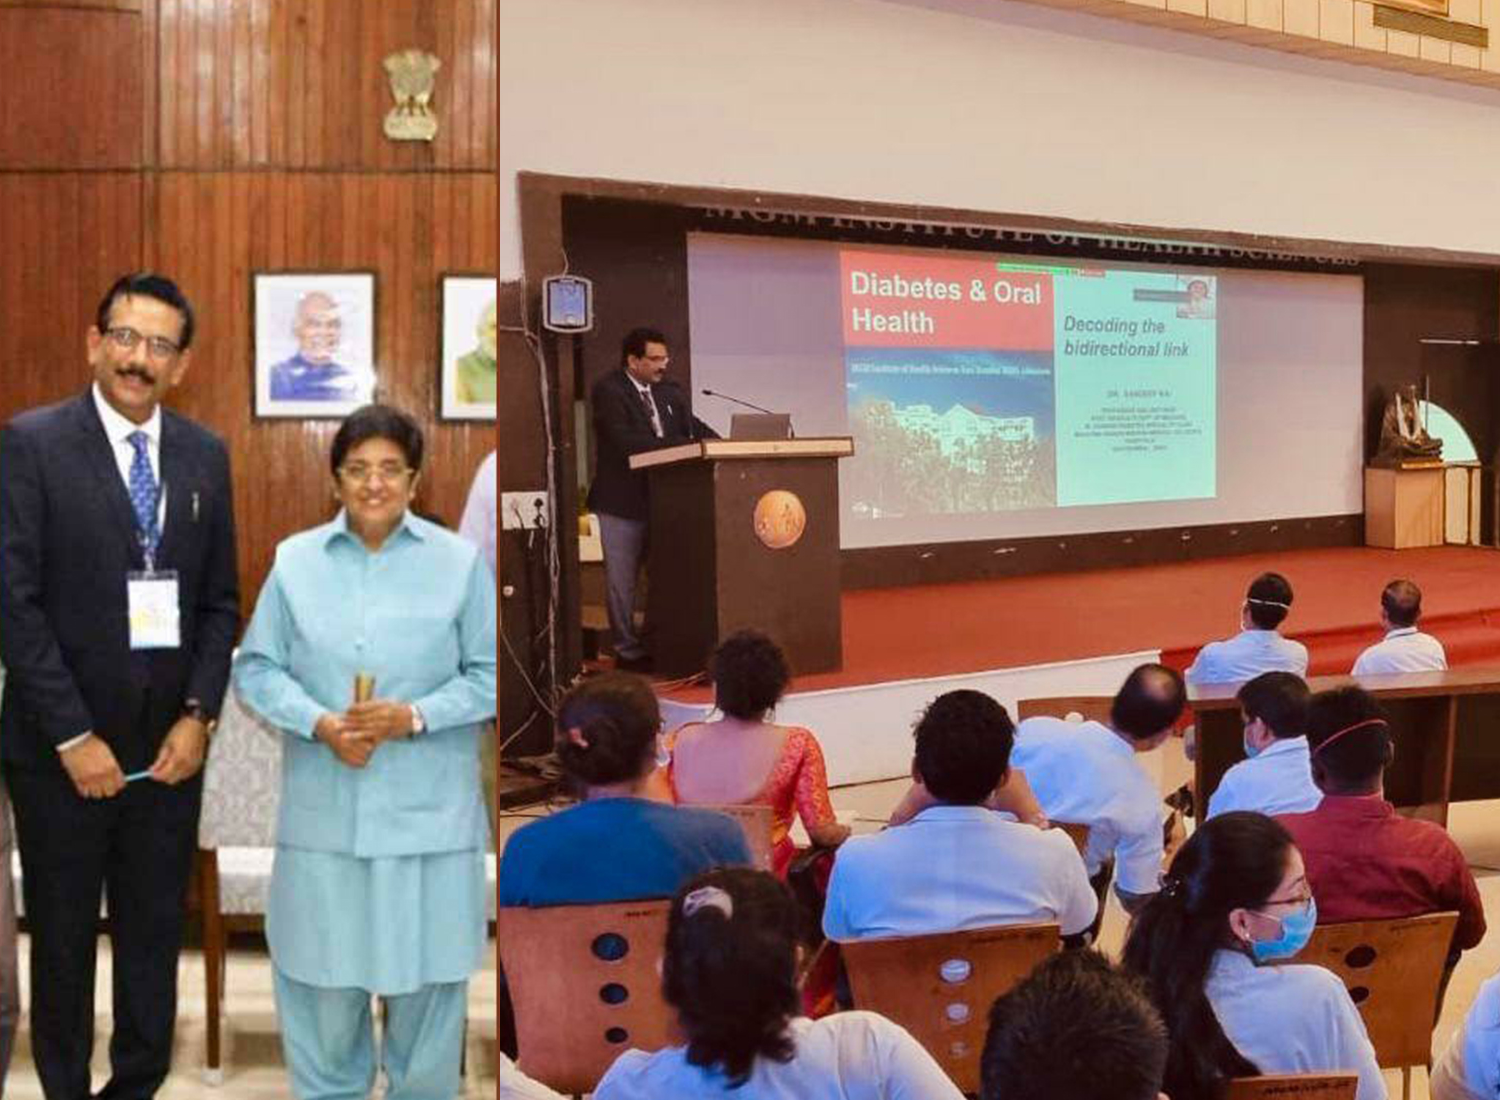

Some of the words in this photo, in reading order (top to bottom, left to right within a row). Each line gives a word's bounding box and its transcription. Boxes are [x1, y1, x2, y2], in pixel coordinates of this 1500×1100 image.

[851, 271, 962, 300] Diabetes
[969, 279, 987, 301] &
[994, 280, 1042, 305] Oral
[852, 308, 934, 334] Health
[1063, 315, 1137, 335] Decoding
[1142, 318, 1166, 333] the
[1064, 340, 1160, 358] bidirectional
[1163, 342, 1189, 358] link
